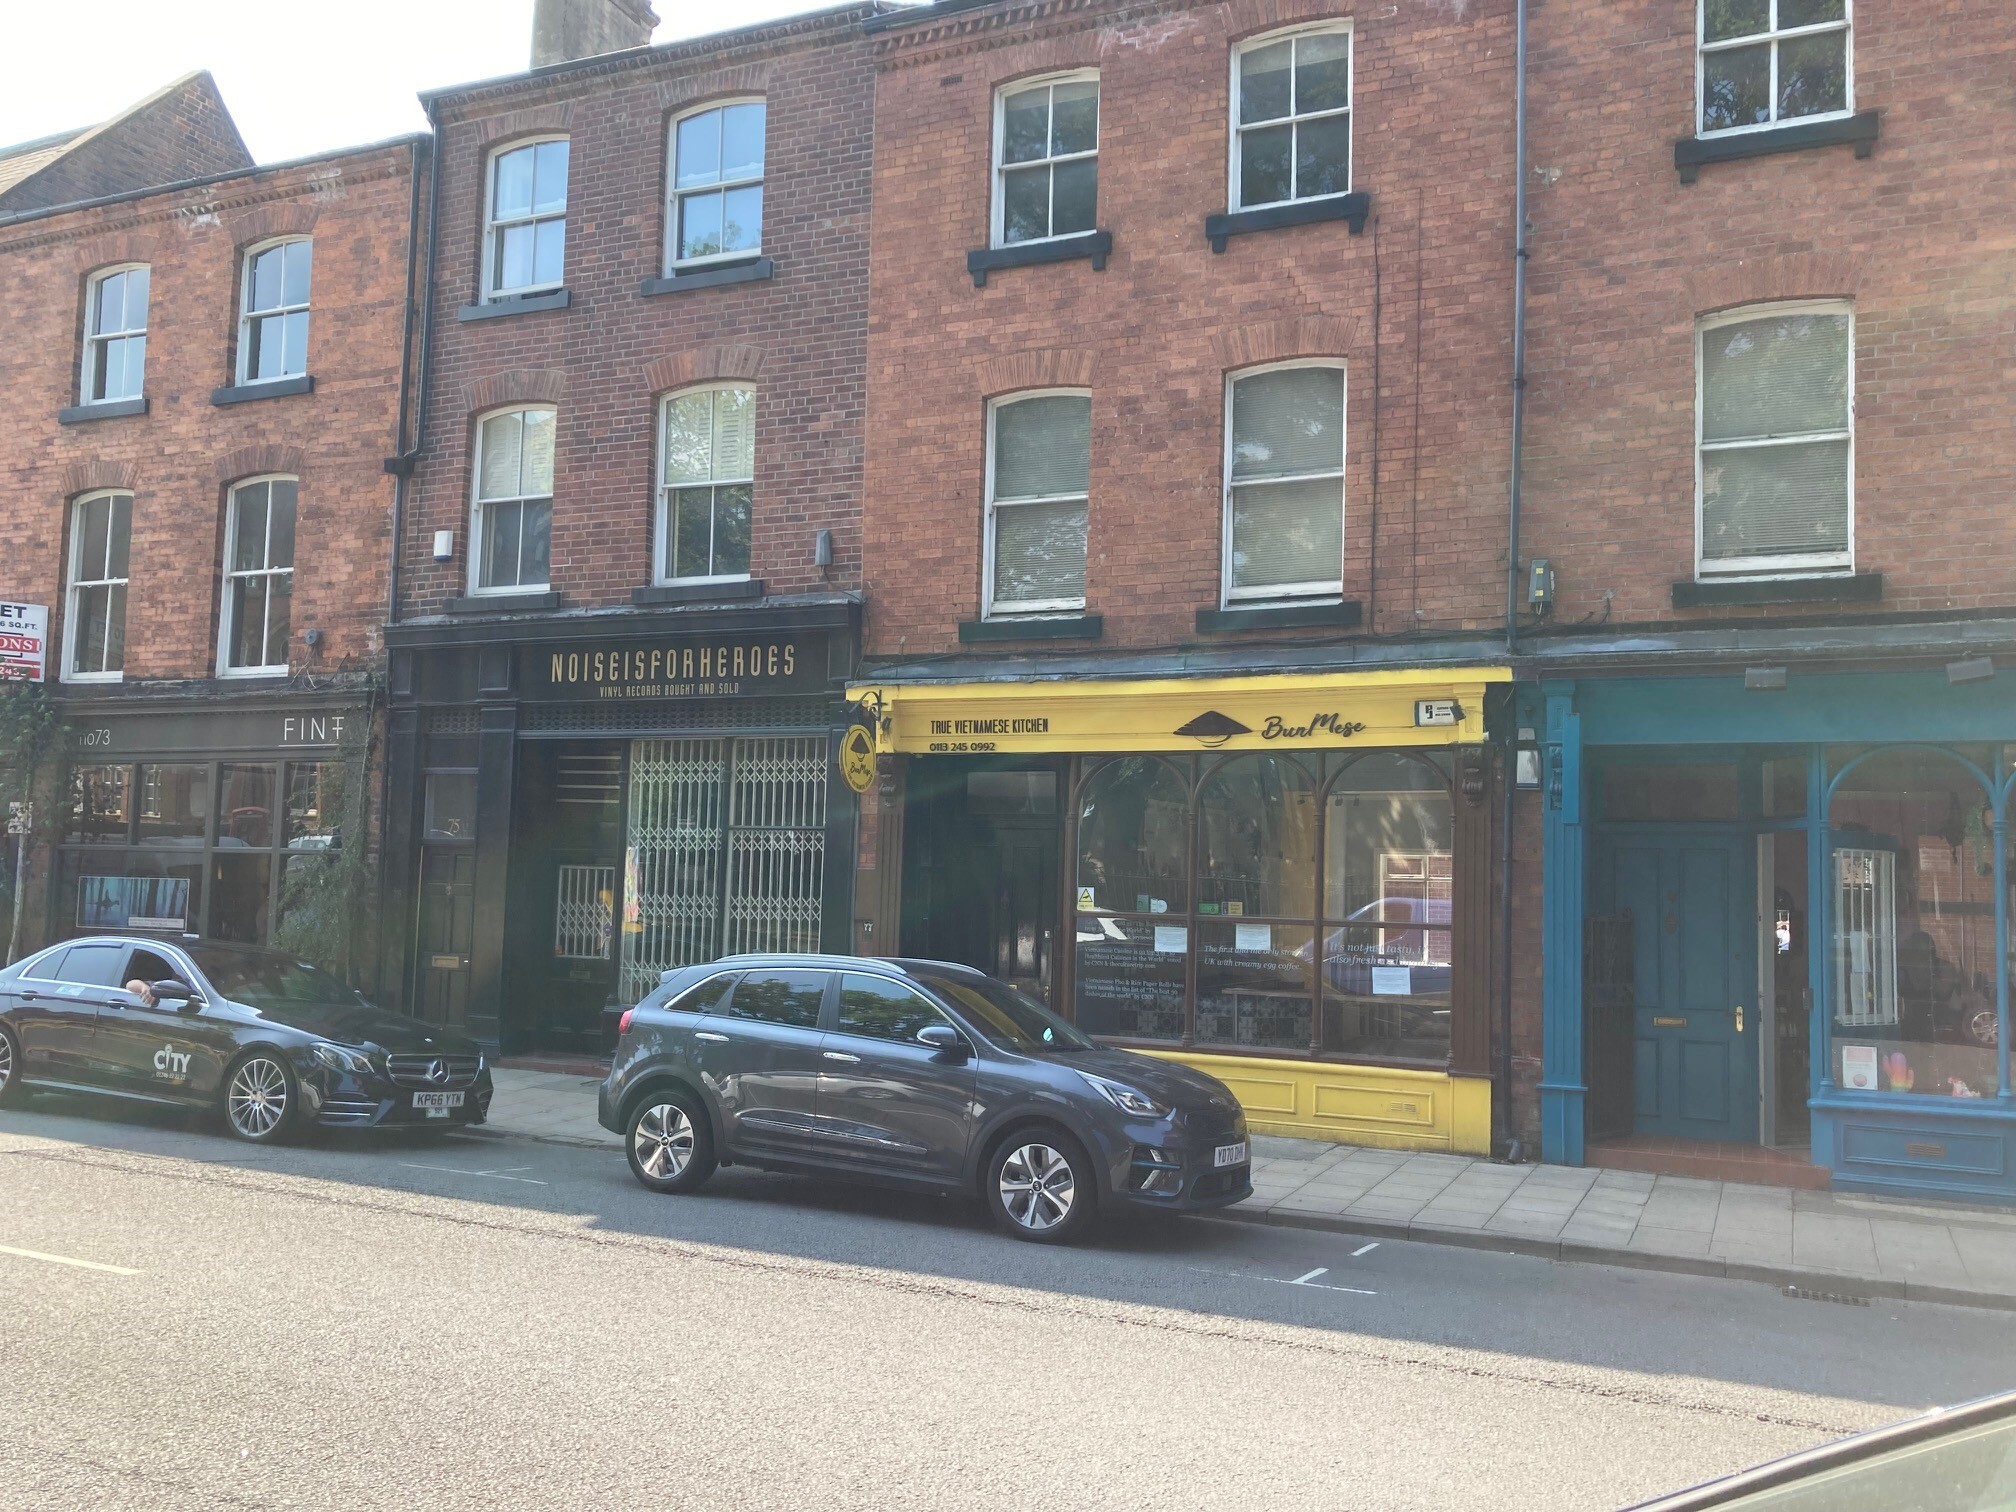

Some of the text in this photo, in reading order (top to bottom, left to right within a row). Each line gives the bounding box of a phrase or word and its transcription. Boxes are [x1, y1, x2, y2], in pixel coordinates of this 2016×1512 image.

[550, 644, 795, 683] NOISEISFORHEROES
[600, 682, 739, 698] VINYL RECORDS BOUGHT AND SOLD
[930, 718, 1049, 735] TRUE VIETNAMESE KITCHEN
[929, 742, 996, 752] 0113 245 0992
[1204, 957, 1216, 965] UK
[1216, 958, 1233, 966] with
[1234, 960, 1262, 970] creamy
[1262, 962, 1277, 970] egg
[417, 1093, 444, 1106] KP66
[1218, 1147, 1234, 1164] YD70
